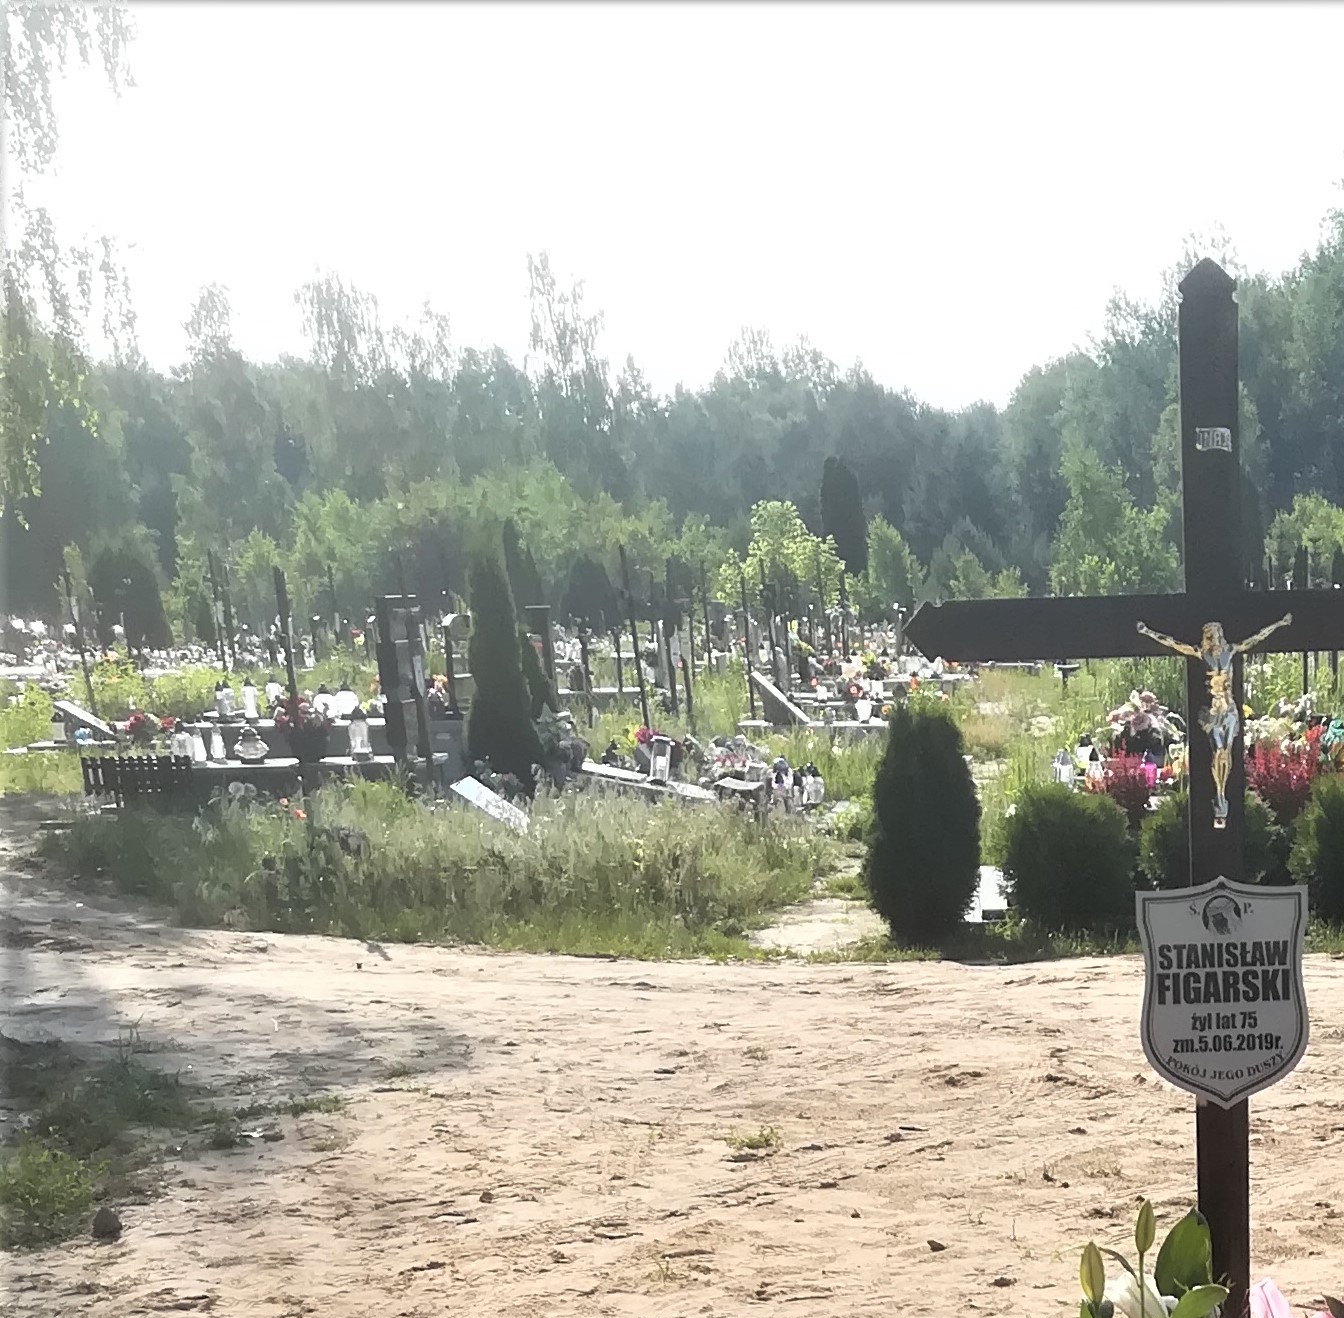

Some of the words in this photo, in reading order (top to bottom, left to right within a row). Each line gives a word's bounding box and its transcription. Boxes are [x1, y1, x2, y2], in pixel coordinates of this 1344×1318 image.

[1158, 939, 1290, 971] STANISŁAW
[1157, 968, 1291, 1006] FIGARSKI
[1215, 1012, 1238, 1030] lat
[1239, 1010, 1259, 1029] 75
[1172, 1032, 1284, 1054] zm.5.06.2019r.
[1166, 1055, 1207, 1078] POKÓJ
[1209, 1069, 1244, 1081] JEGO
[1246, 1051, 1284, 1077] DUSZY
